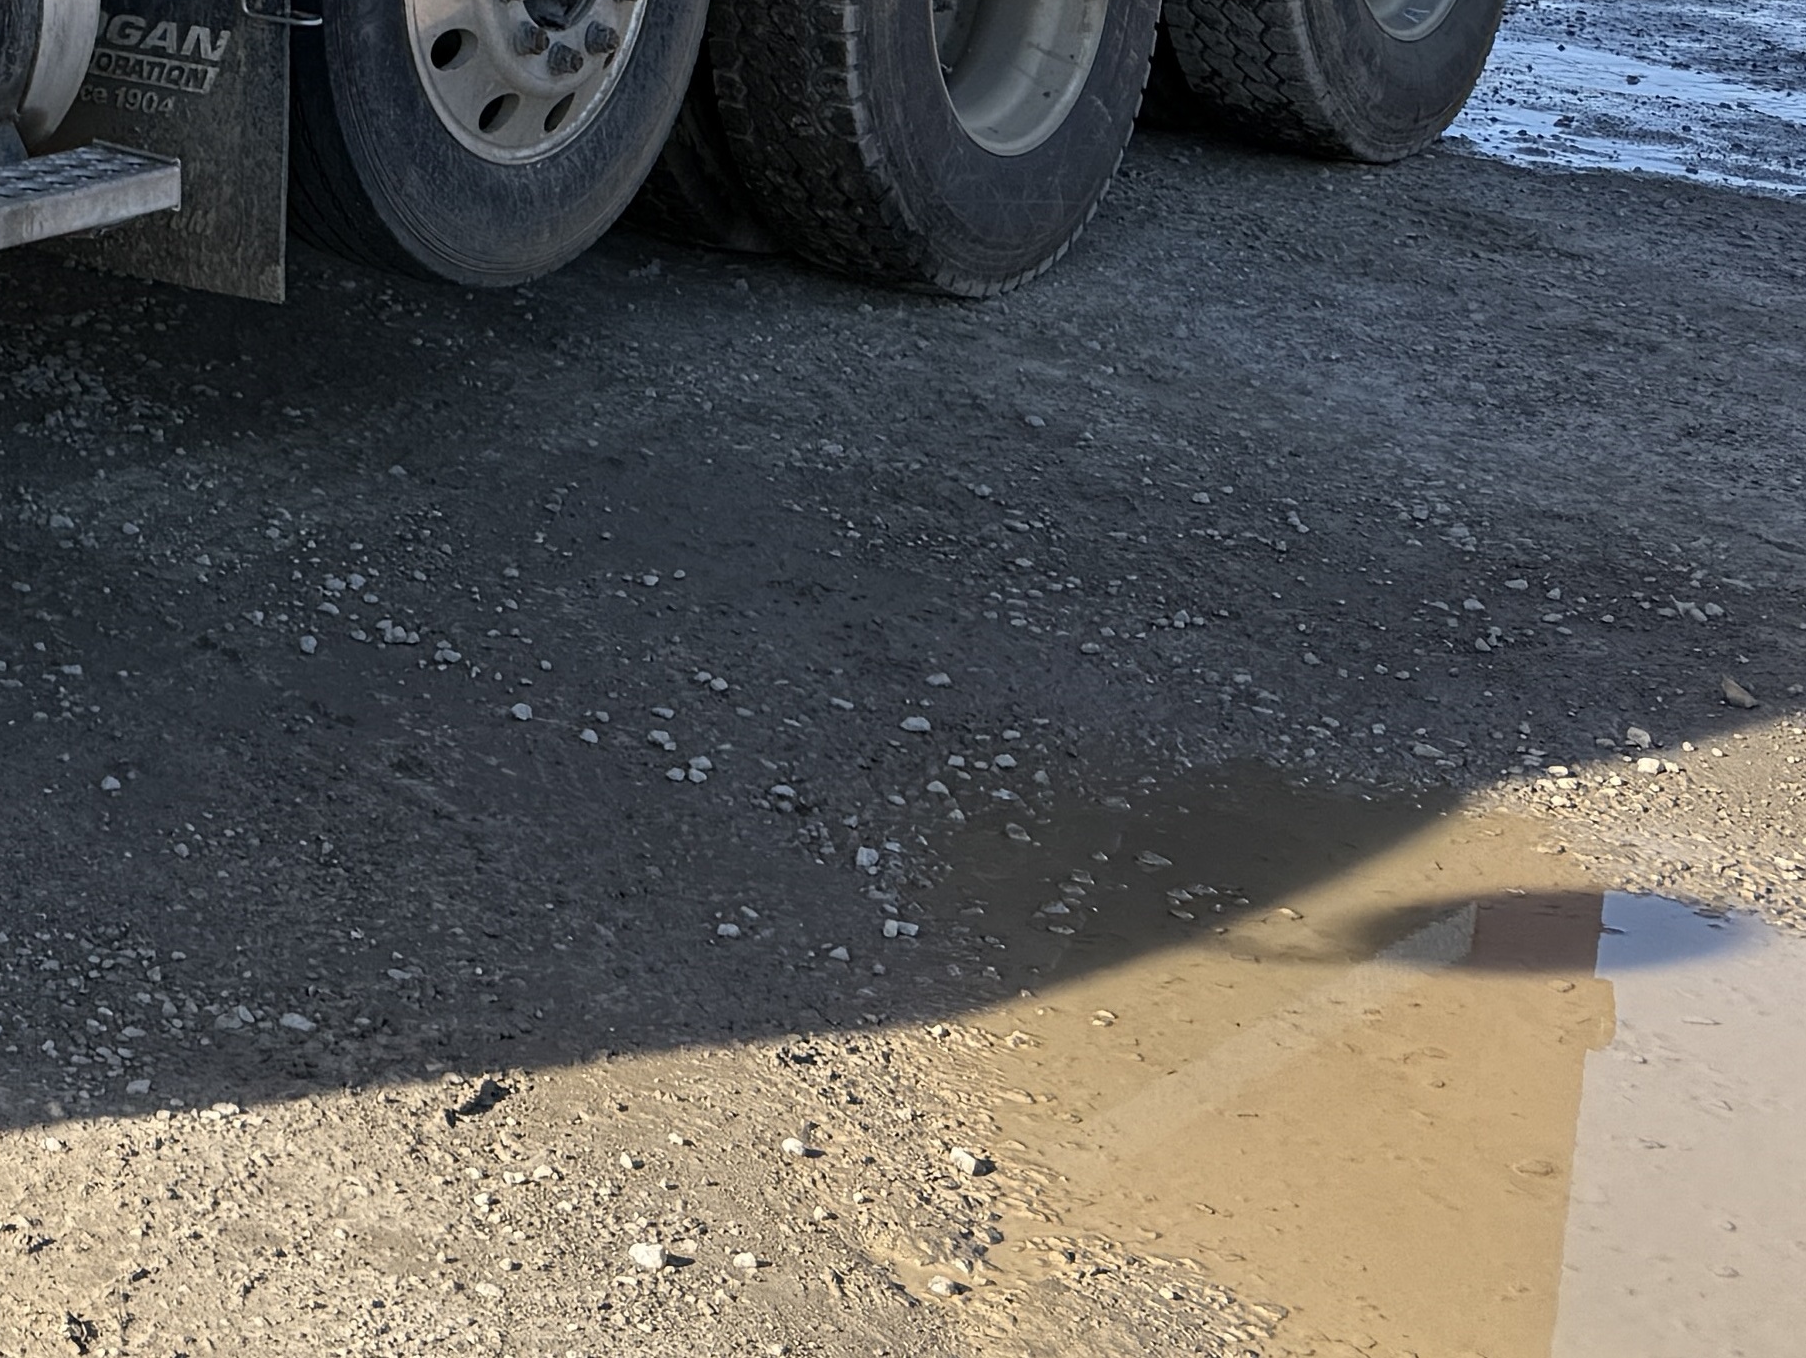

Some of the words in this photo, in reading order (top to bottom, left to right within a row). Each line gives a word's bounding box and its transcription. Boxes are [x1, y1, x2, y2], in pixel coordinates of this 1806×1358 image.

[98, 11, 232, 62] GAN
[90, 50, 209, 91] ORATION
[115, 86, 175, 117] 1904
